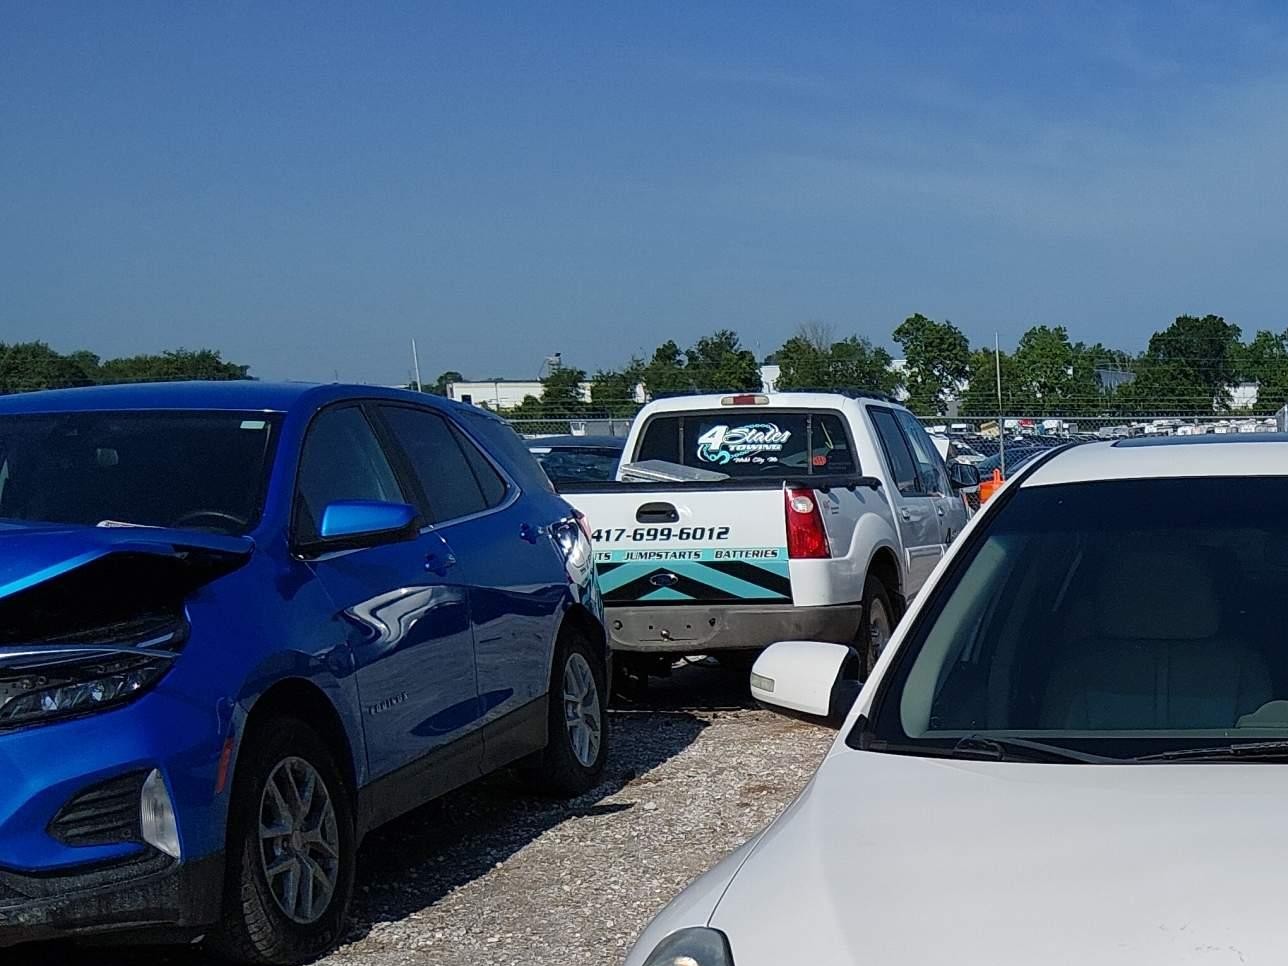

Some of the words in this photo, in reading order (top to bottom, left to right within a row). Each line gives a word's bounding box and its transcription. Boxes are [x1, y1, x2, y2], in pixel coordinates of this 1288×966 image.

[697, 425, 729, 451] 4
[723, 428, 792, 444] States
[728, 443, 783, 452] TOWING
[592, 527, 730, 542] 417-699-6012
[624, 551, 701, 560] JUMPSTARTS
[714, 550, 778, 559] BATTERIES
